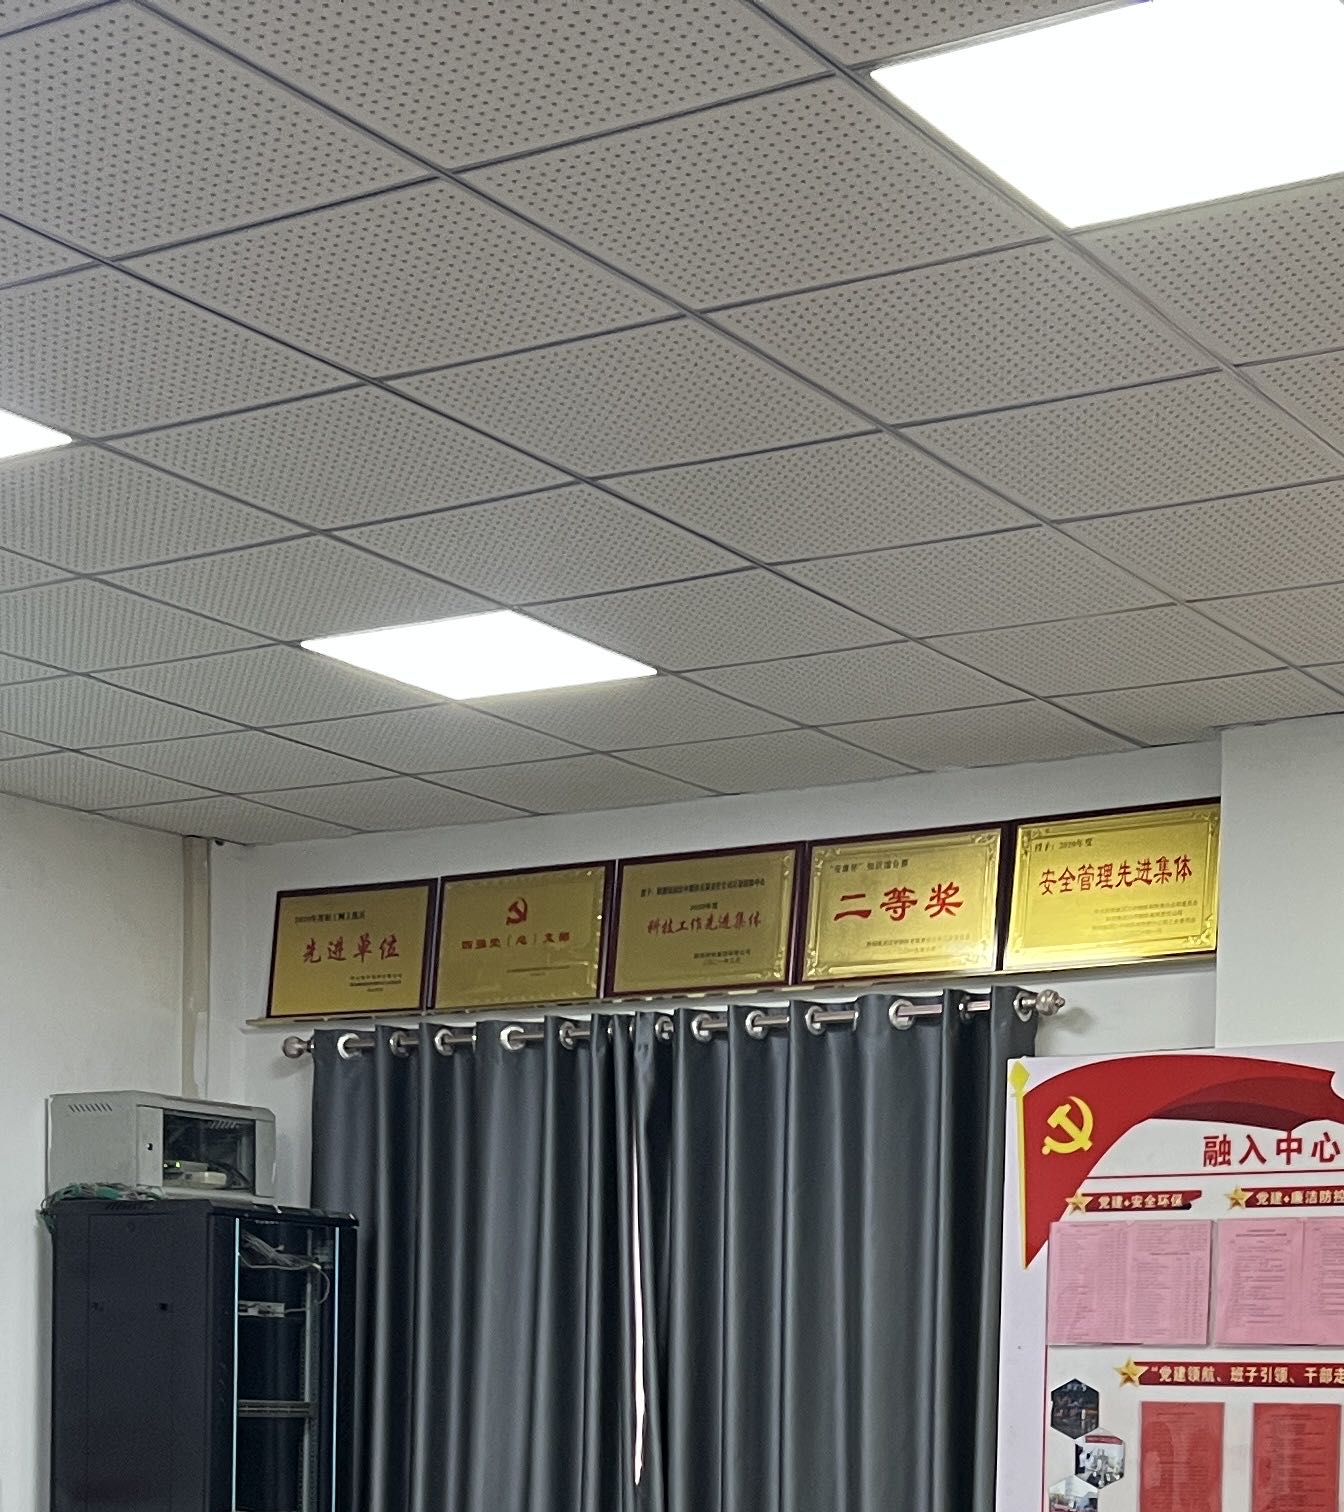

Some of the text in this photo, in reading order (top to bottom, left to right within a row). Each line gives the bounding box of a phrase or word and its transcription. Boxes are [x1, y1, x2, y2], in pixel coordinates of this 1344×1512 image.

[1039, 854, 1193, 896] 安全管理先进集体
[833, 881, 964, 922] 二等奖
[646, 911, 762, 936] 科技工作先进集体
[302, 932, 400, 964] 先进单位
